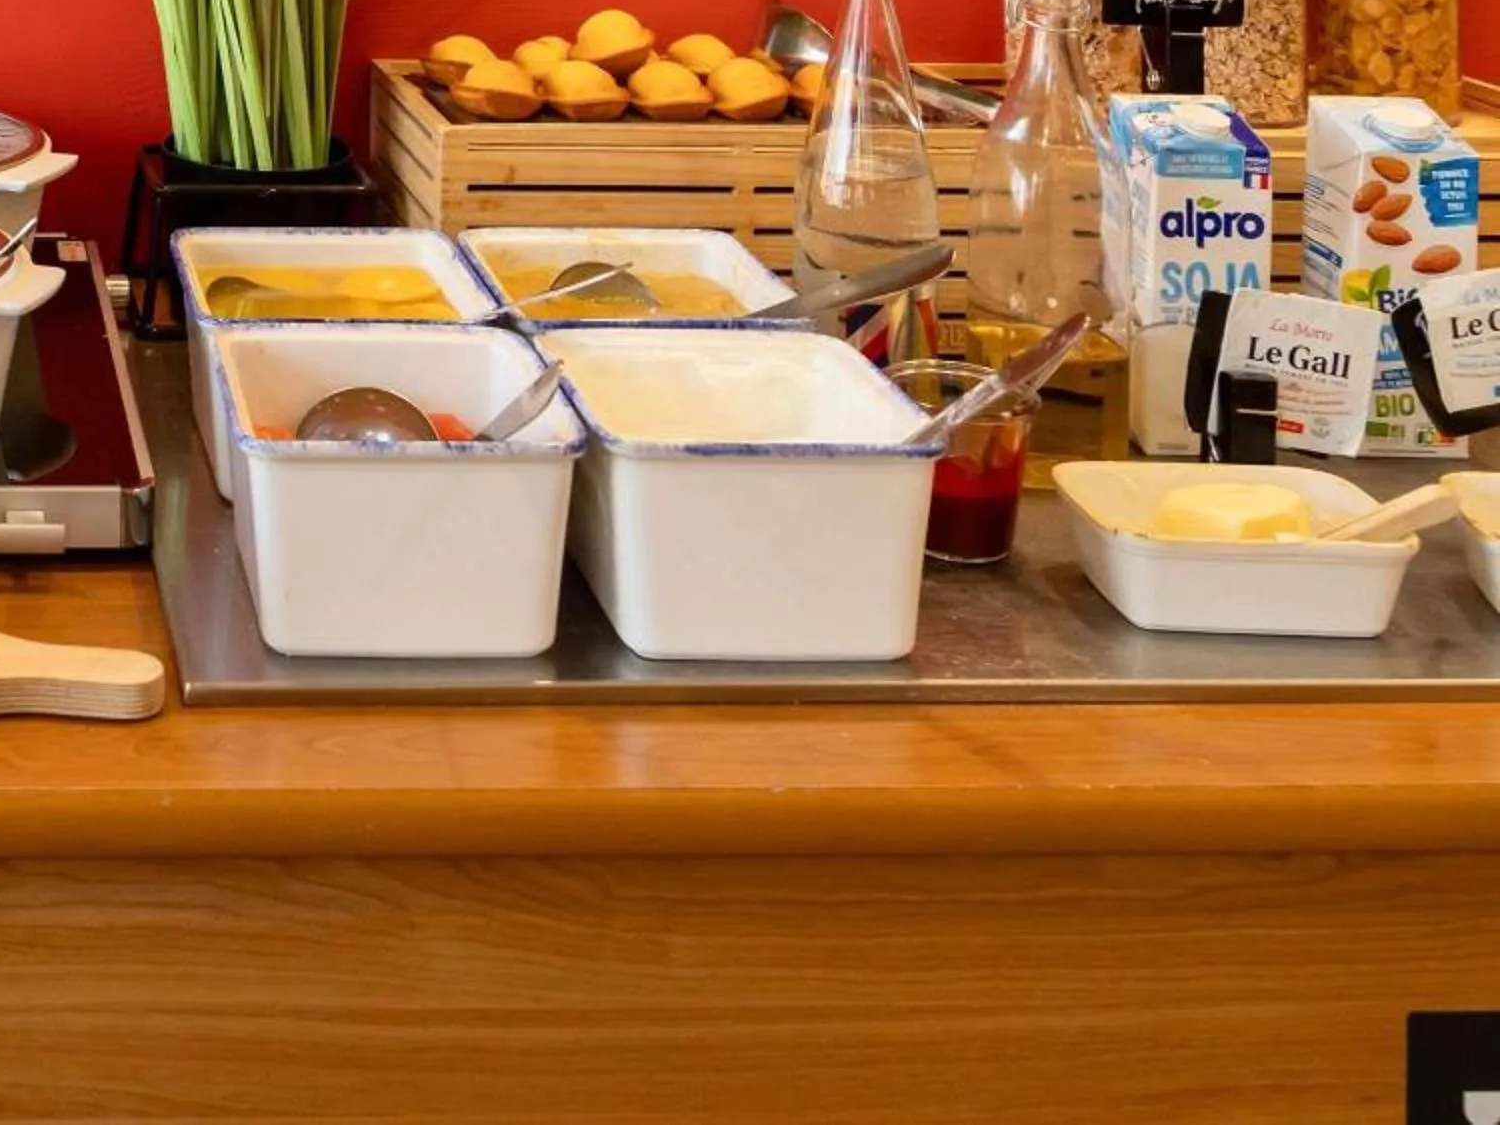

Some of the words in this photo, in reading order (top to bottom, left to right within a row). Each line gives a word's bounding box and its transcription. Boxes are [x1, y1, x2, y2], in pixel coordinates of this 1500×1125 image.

[1160, 197, 1265, 249] alpro
[1159, 260, 1261, 303] SOJA
[1450, 316, 1484, 339] Le
[1247, 336, 1282, 365] Le
[1288, 344, 1352, 380] Gall
[1375, 393, 1415, 418] BIO
